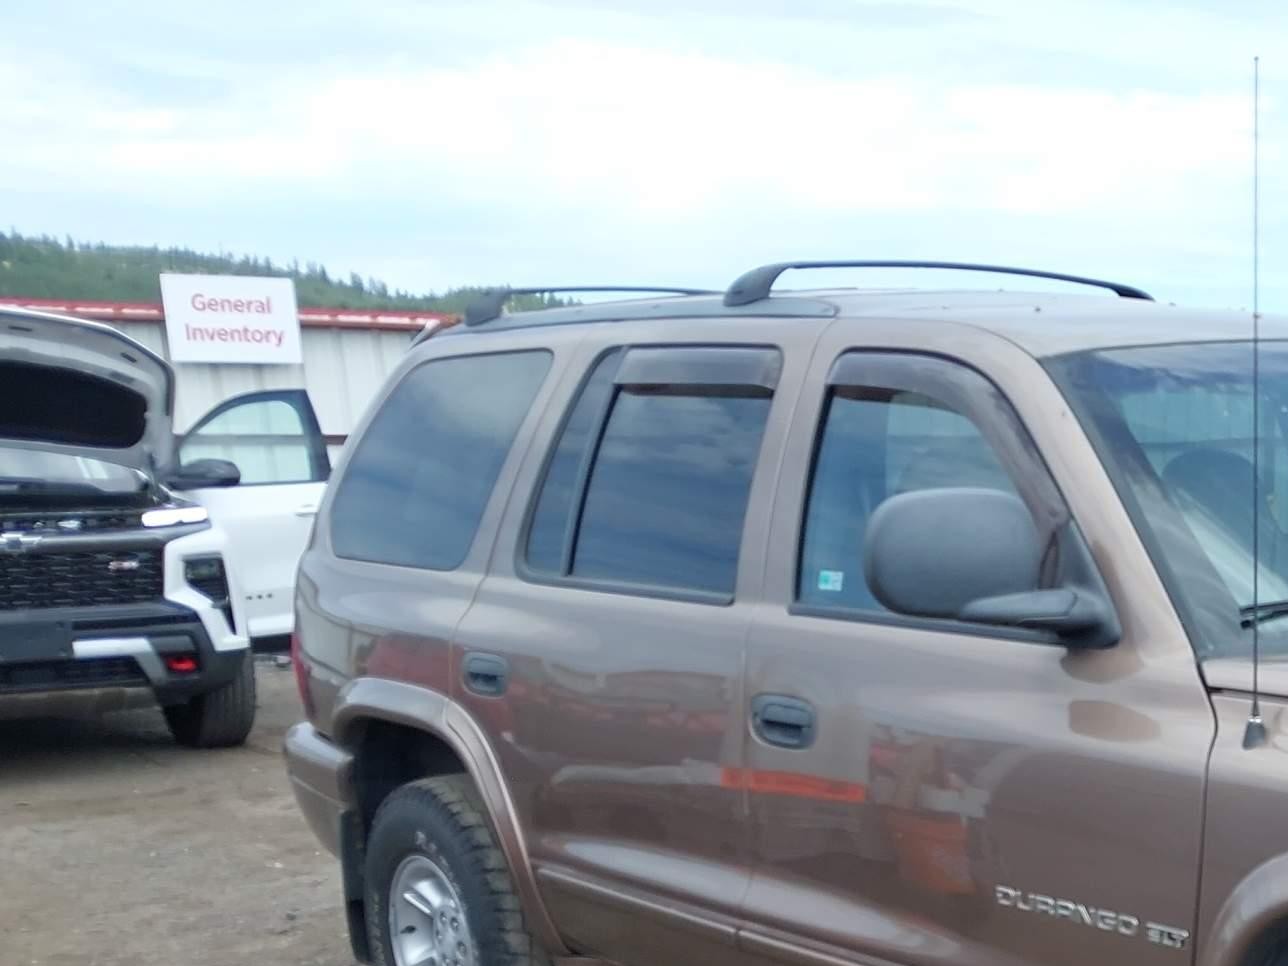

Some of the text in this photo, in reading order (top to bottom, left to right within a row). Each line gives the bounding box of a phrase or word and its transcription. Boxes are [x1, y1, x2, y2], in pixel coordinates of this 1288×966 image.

[191, 293, 272, 314] General
[184, 323, 284, 347] Inventory
[995, 885, 1139, 936] DURANGO
